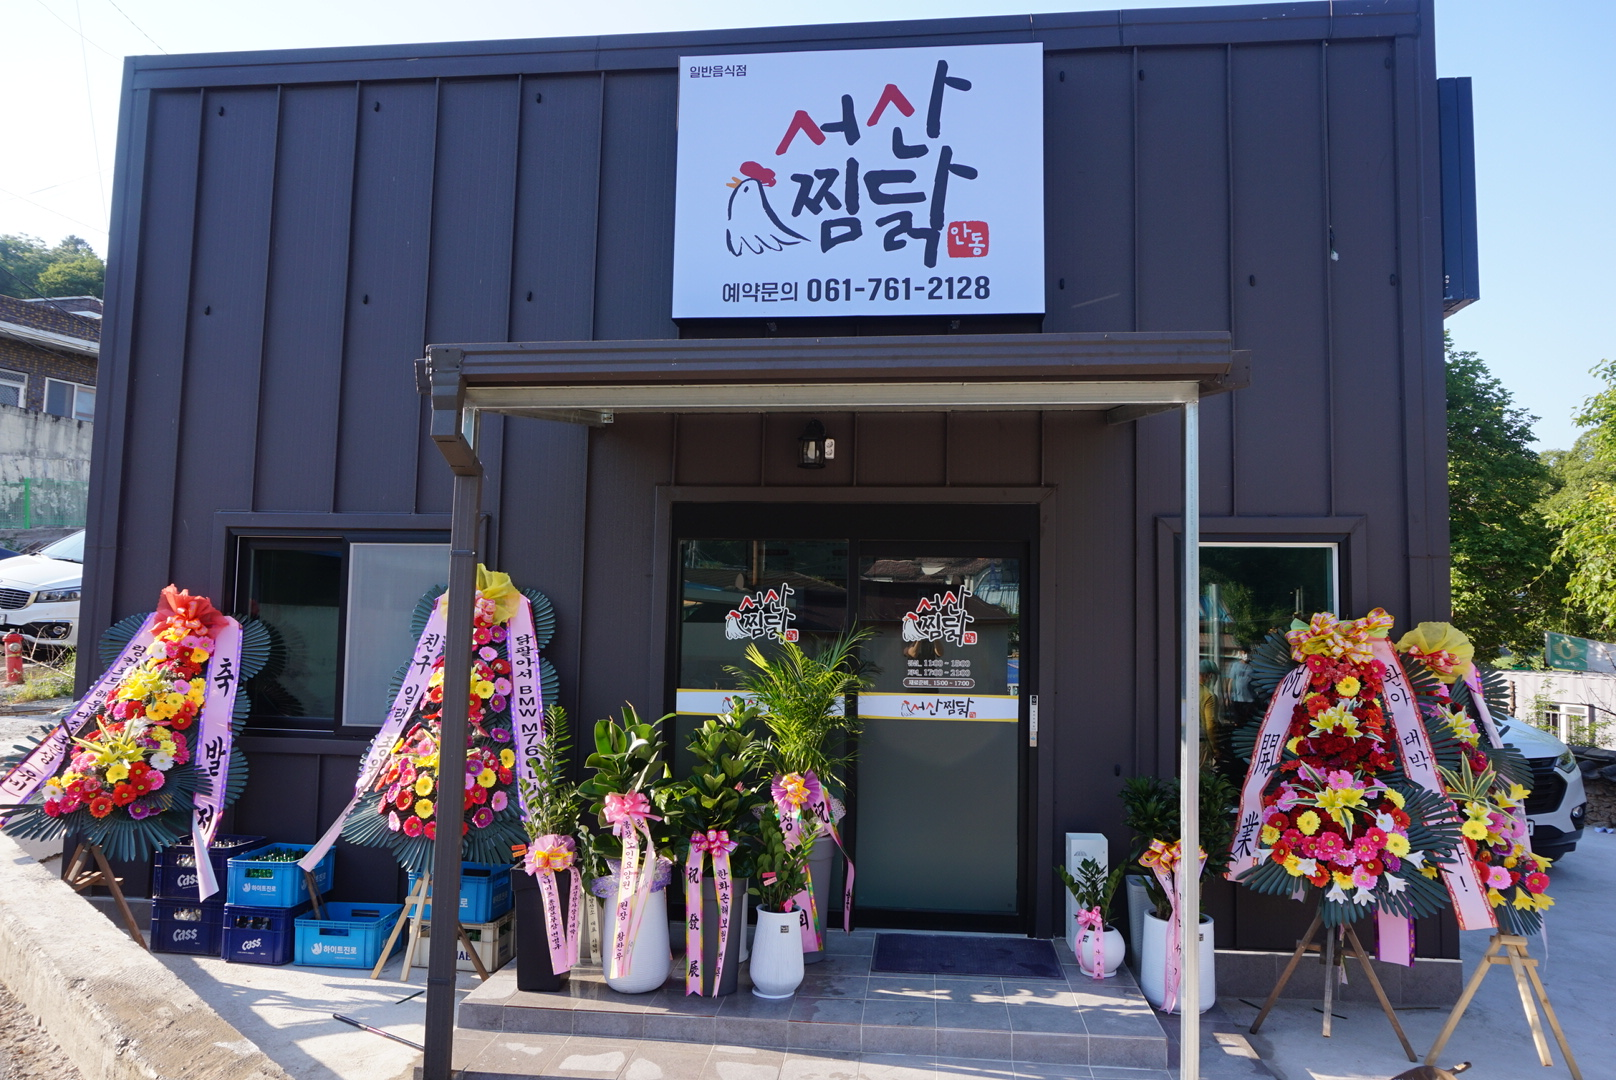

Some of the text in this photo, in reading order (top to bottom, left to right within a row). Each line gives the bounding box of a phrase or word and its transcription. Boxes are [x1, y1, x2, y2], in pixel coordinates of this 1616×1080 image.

[689, 64, 747, 79] 일반음식점
[775, 59, 972, 159] 서산
[790, 145, 978, 268] 찜닭
[950, 223, 986, 255] 안동
[722, 276, 990, 303] 예약문의 061-761-2128
[739, 583, 794, 613] 서산
[916, 585, 971, 616] 서산
[743, 608, 796, 644] 찜닭
[920, 610, 976, 647] 찜닭
[414, 633, 440, 675] 친구
[519, 685, 537, 717] BMW
[1403, 727, 1430, 772] 대박
[177, 874, 199, 887] Cass
[251, 884, 277, 892] 하이트진로
[619, 901, 628, 920] 원장
[173, 929, 198, 942] Cass
[242, 938, 262, 950] Cass
[323, 944, 357, 955] 하이트진로
